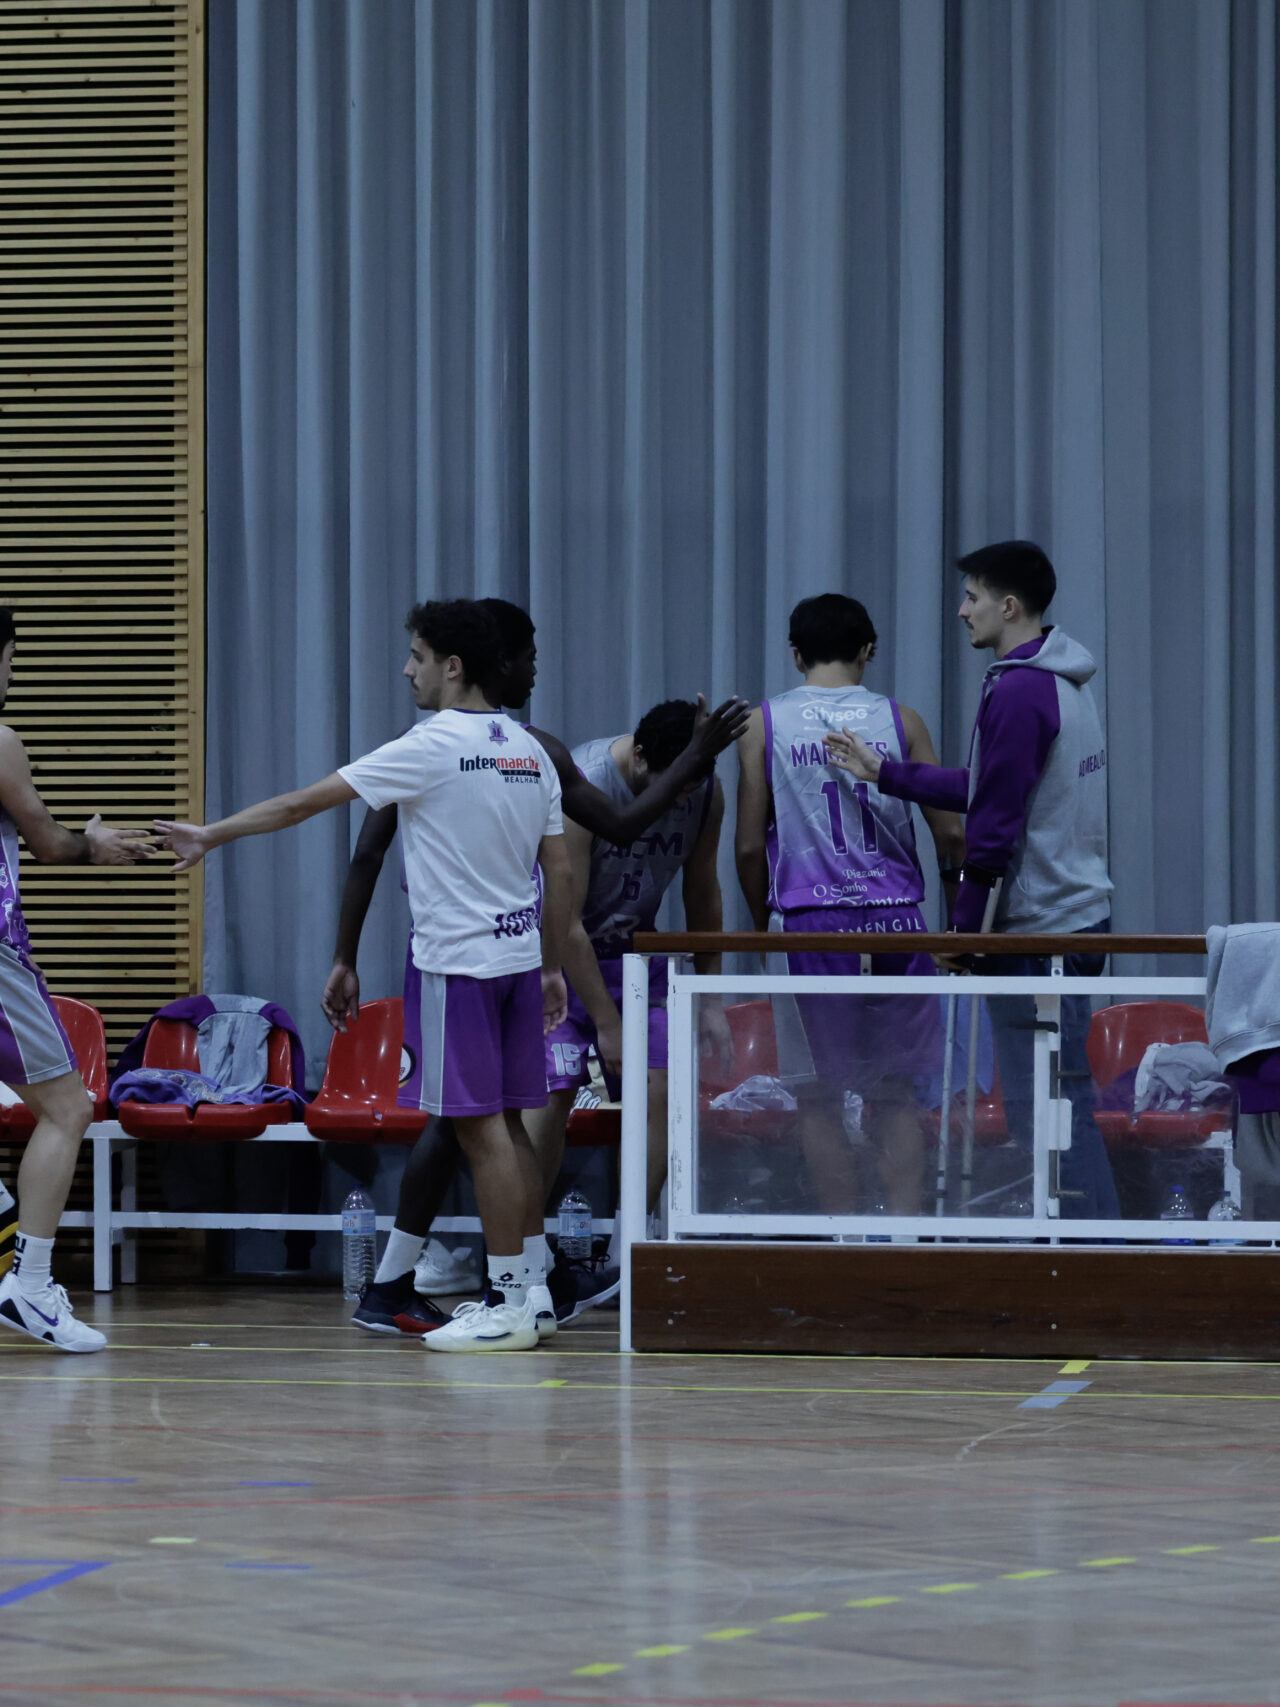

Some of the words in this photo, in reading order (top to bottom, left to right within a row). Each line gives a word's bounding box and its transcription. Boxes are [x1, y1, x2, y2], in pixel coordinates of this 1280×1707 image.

[791, 740, 888, 767] MARS
[819, 779, 880, 856] 11
[841, 867, 887, 882] Pizzaria
[812, 884, 828, 898] O
[829, 881, 868, 898] Sonho
[550, 1042, 582, 1076] 15
